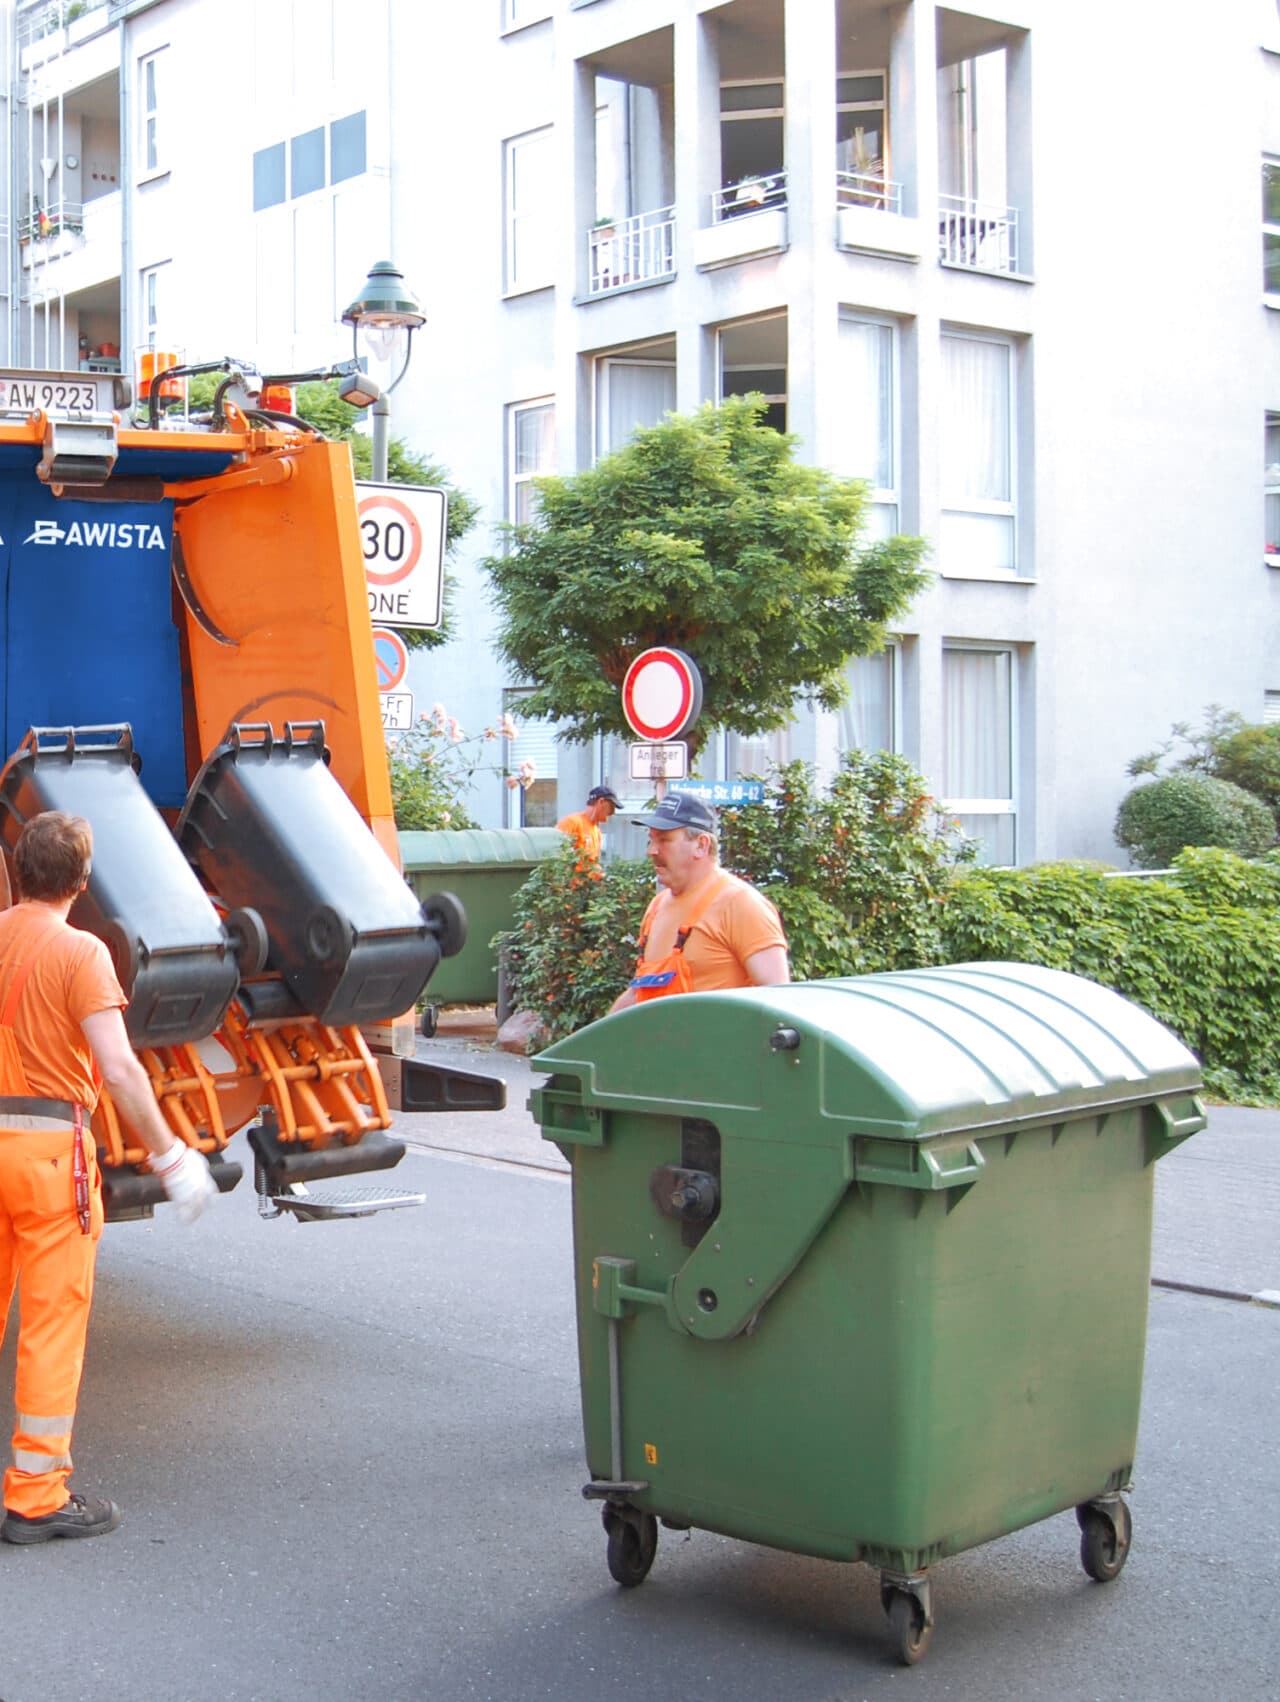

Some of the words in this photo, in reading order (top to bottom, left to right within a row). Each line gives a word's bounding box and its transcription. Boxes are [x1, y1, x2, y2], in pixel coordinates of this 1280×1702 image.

[9, 384, 36, 408] AW
[41, 385, 94, 411] 9223
[64, 521, 166, 550] AWISTA
[361, 519, 405, 562] 30
[368, 592, 409, 615] ONE
